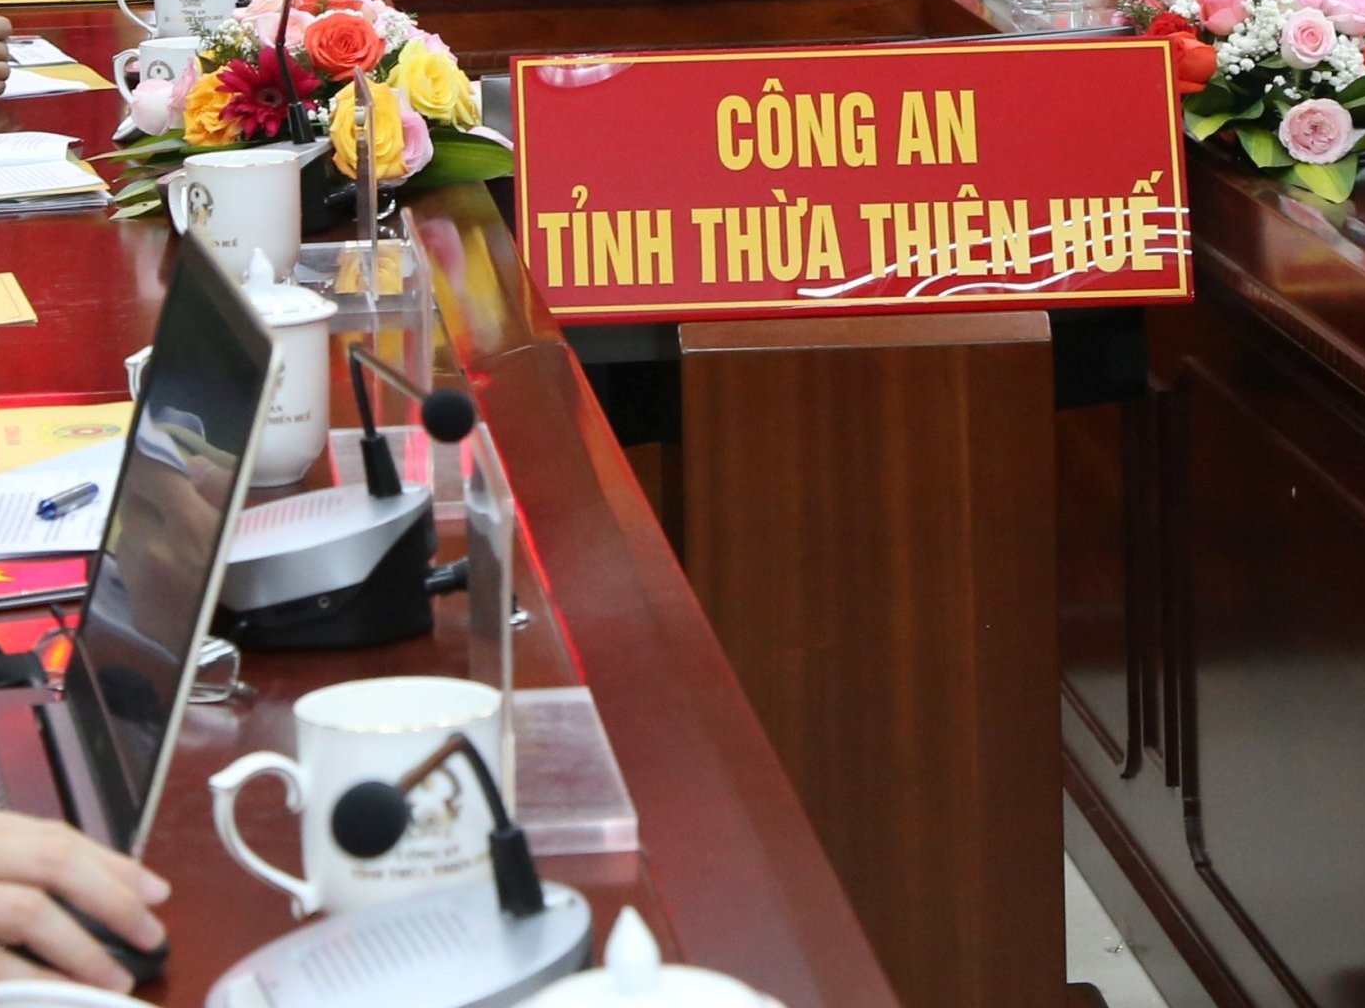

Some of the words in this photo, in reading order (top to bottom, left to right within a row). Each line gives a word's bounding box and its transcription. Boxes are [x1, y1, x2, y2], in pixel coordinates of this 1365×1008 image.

[716, 78, 877, 170] CÔNG
[897, 89, 978, 165] AN
[538, 184, 674, 287] TỈNH
[692, 188, 845, 283] THỪA
[860, 184, 1030, 280] THIÊN
[1051, 170, 1164, 273] HUẾ
